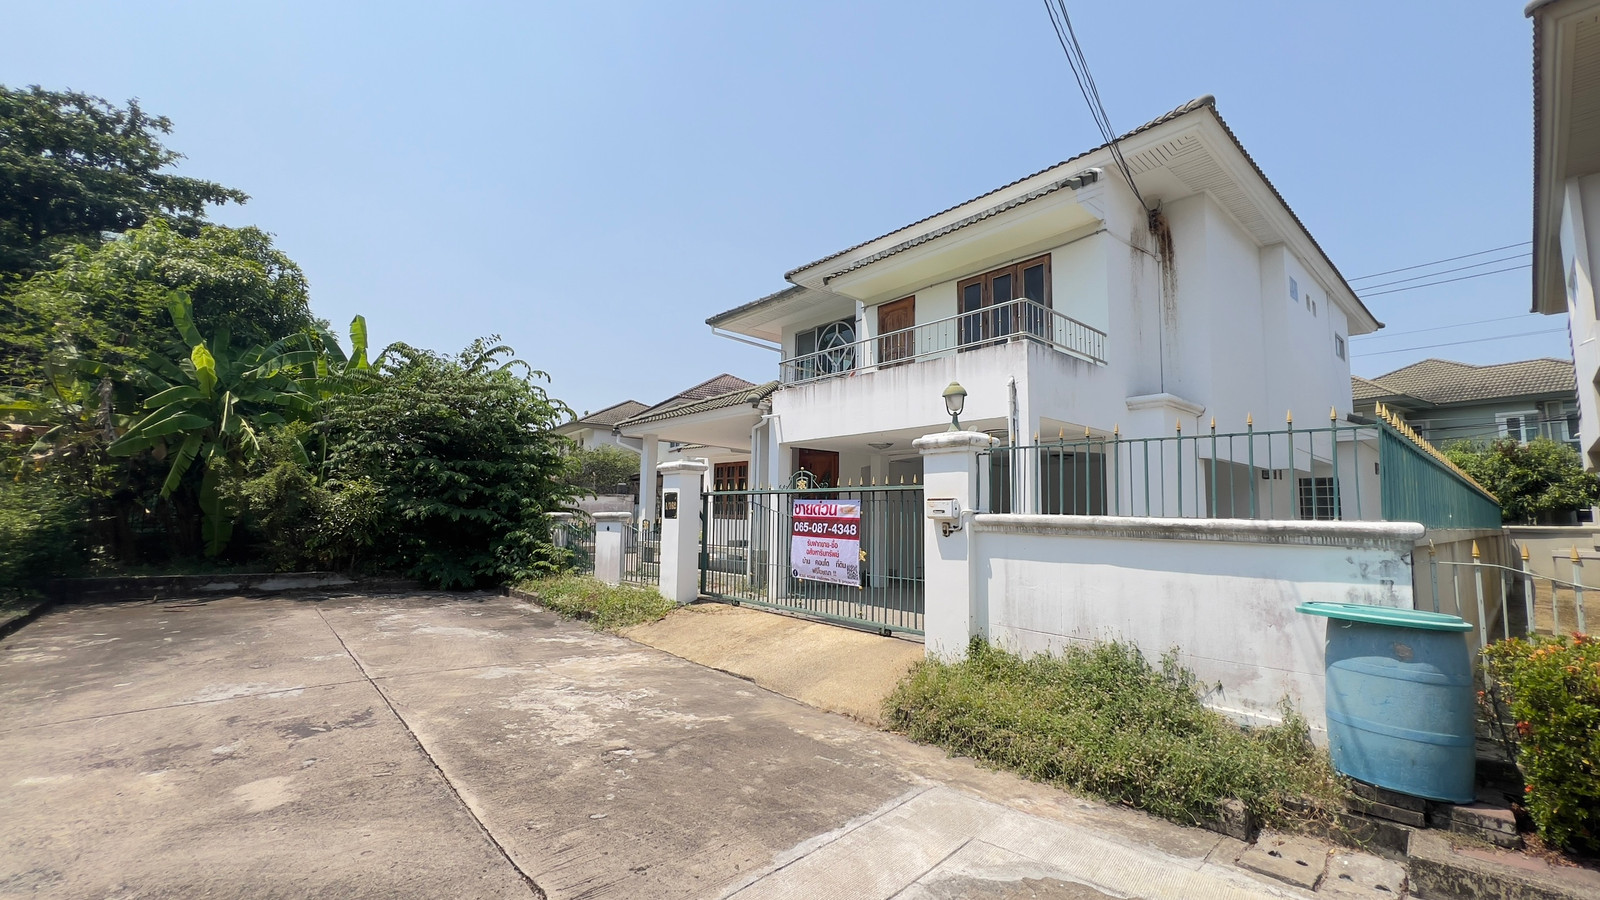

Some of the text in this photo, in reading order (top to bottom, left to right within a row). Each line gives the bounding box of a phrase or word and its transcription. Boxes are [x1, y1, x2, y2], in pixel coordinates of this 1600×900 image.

[794, 501, 838, 516] ขายด่วน
[794, 522, 857, 535] 065-087-4348
